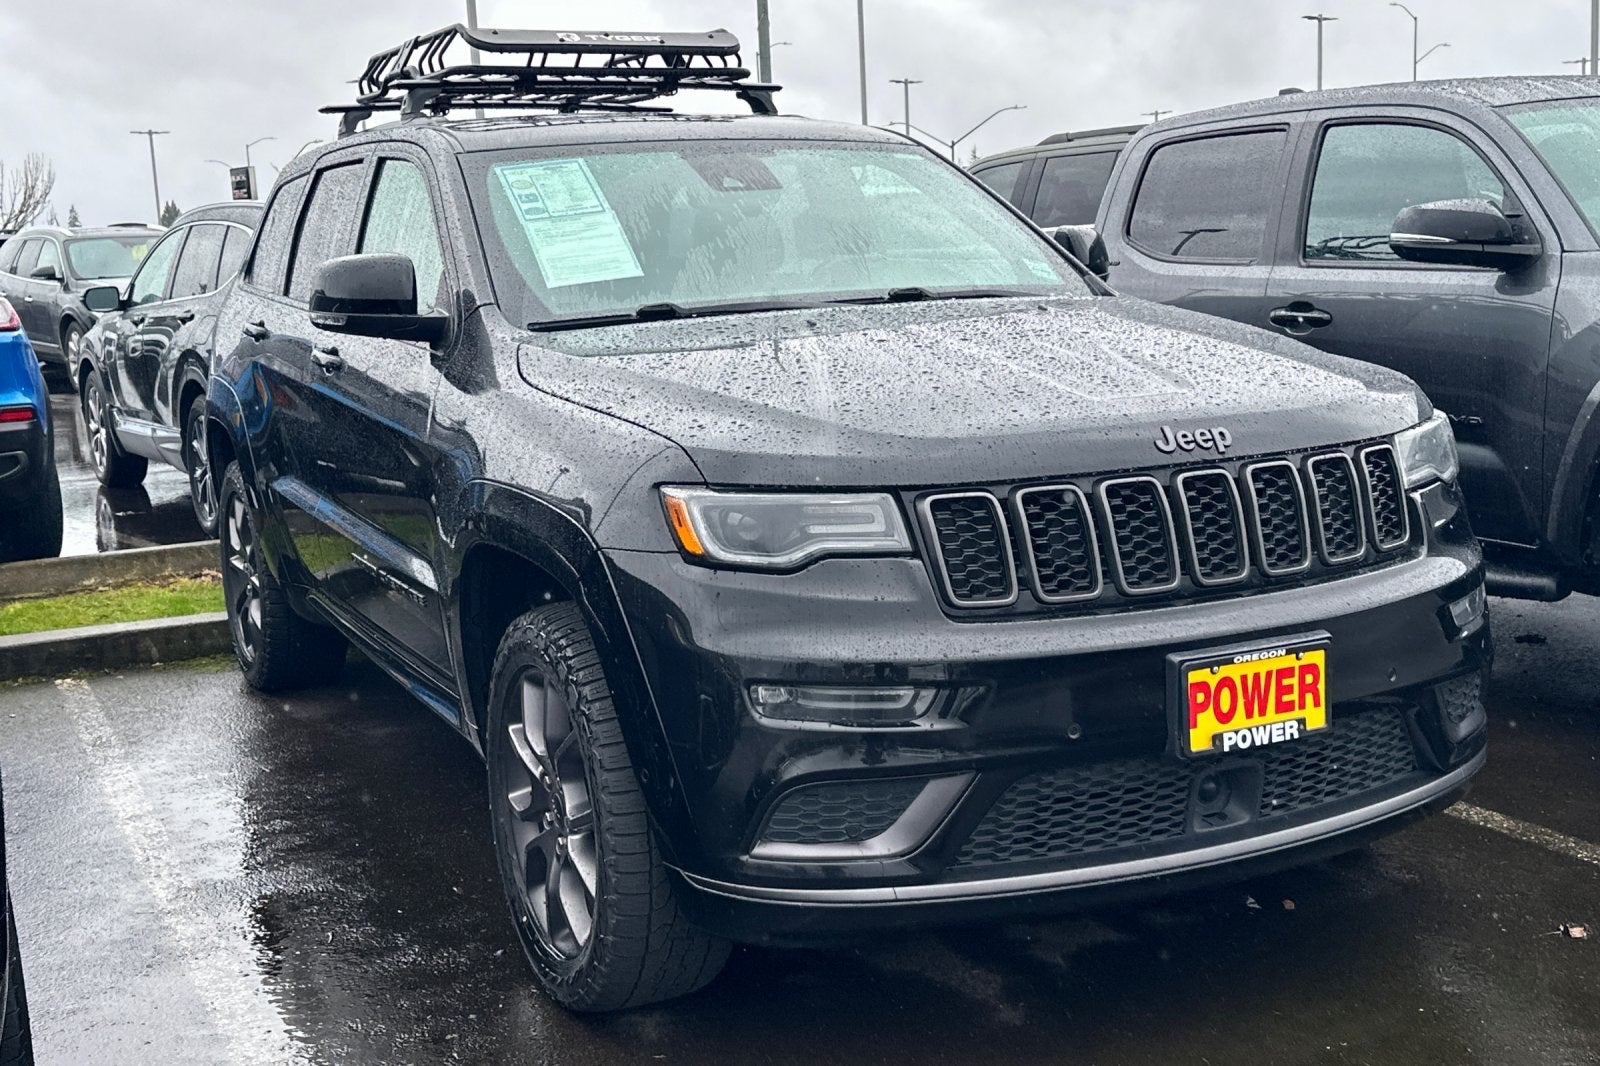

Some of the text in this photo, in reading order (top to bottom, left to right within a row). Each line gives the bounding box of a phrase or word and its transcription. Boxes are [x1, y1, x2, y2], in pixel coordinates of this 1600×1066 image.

[584, 34, 661, 42] TYGER
[1154, 425, 1232, 454] Jeep
[1233, 649, 1287, 664] OREGON
[1189, 662, 1321, 730] POWER
[1222, 720, 1300, 752] POWER
